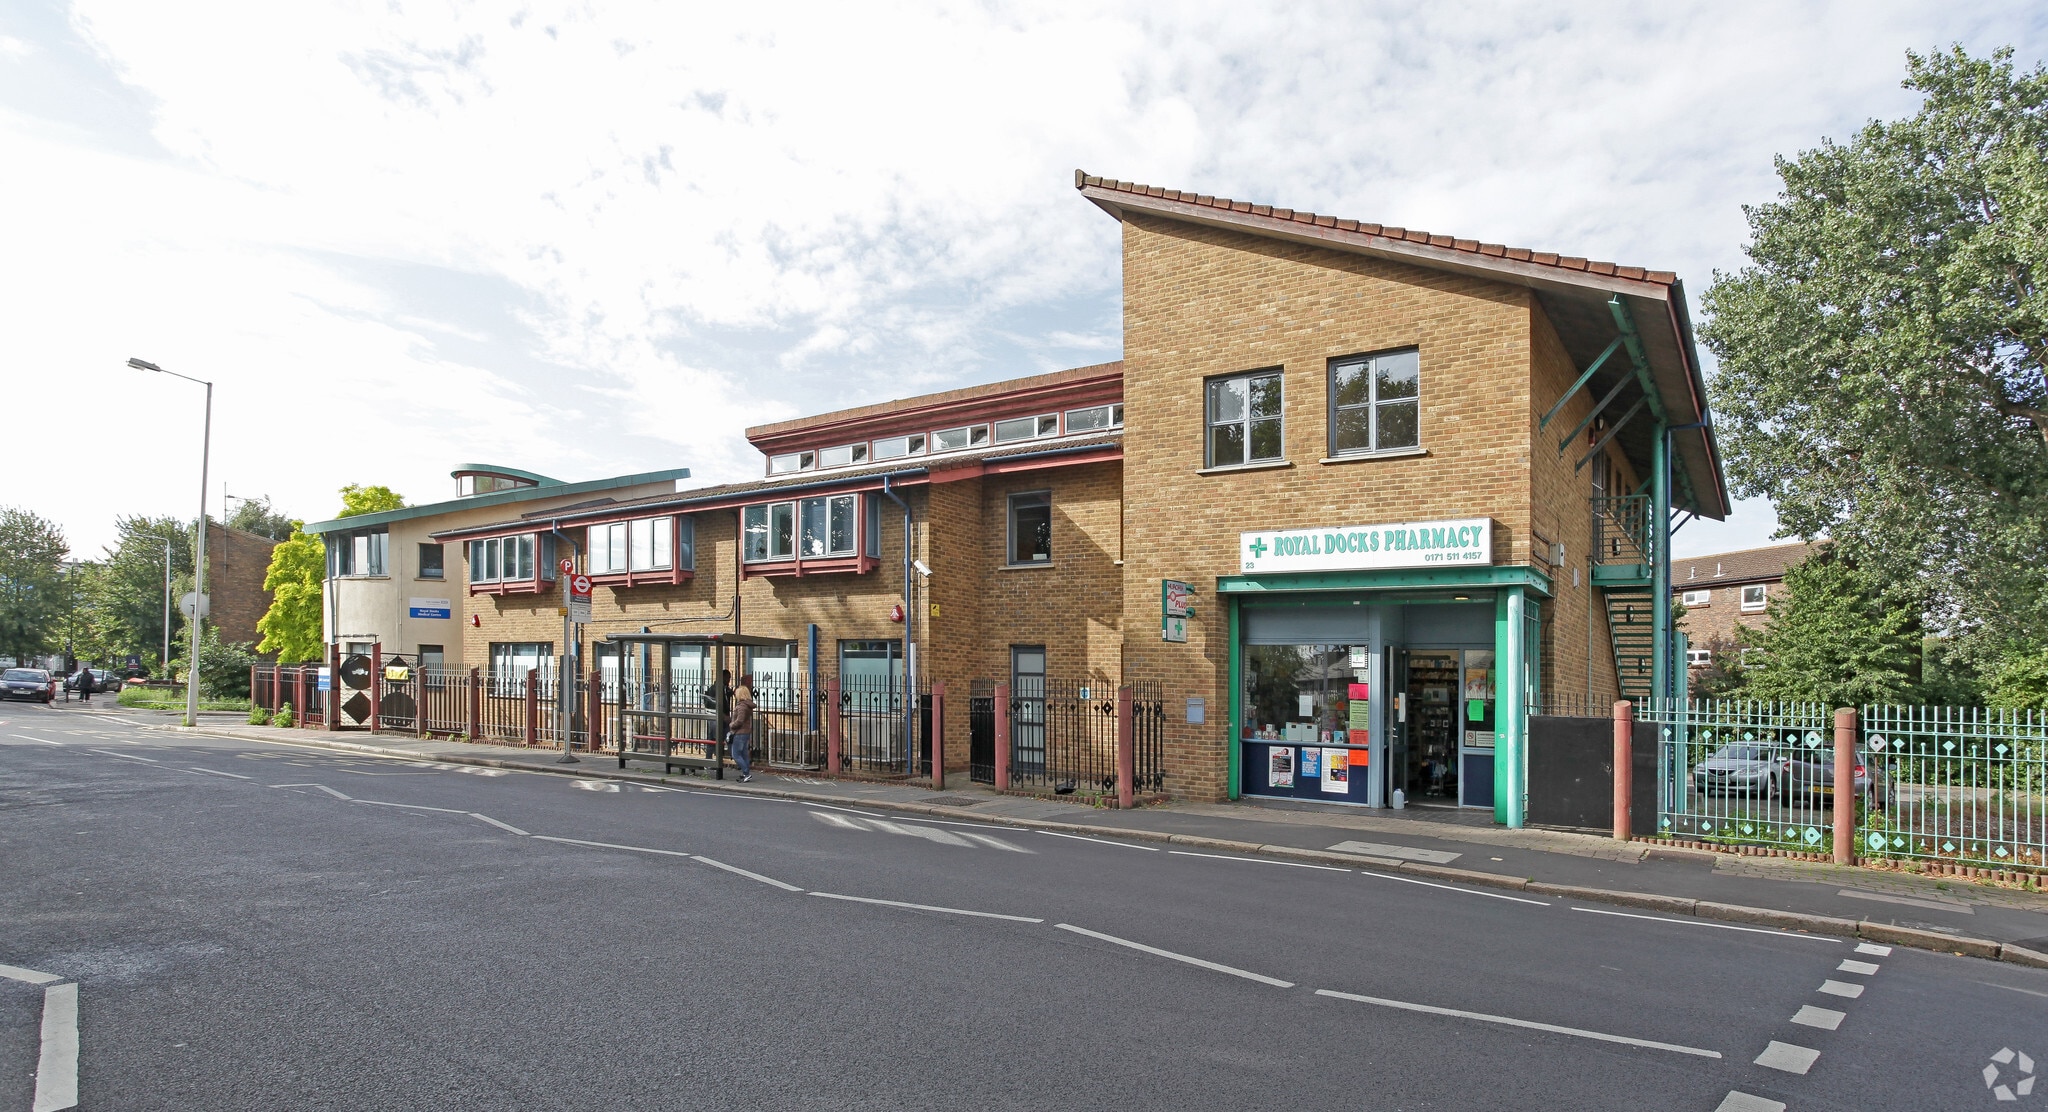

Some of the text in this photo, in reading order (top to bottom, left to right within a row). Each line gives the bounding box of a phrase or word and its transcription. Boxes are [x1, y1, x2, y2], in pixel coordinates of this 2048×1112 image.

[1274, 525, 1483, 556] ROYAL DOCKS PHARMACY
[1425, 551, 1482, 562] 0171 511 4157
[565, 561, 572, 571] P
